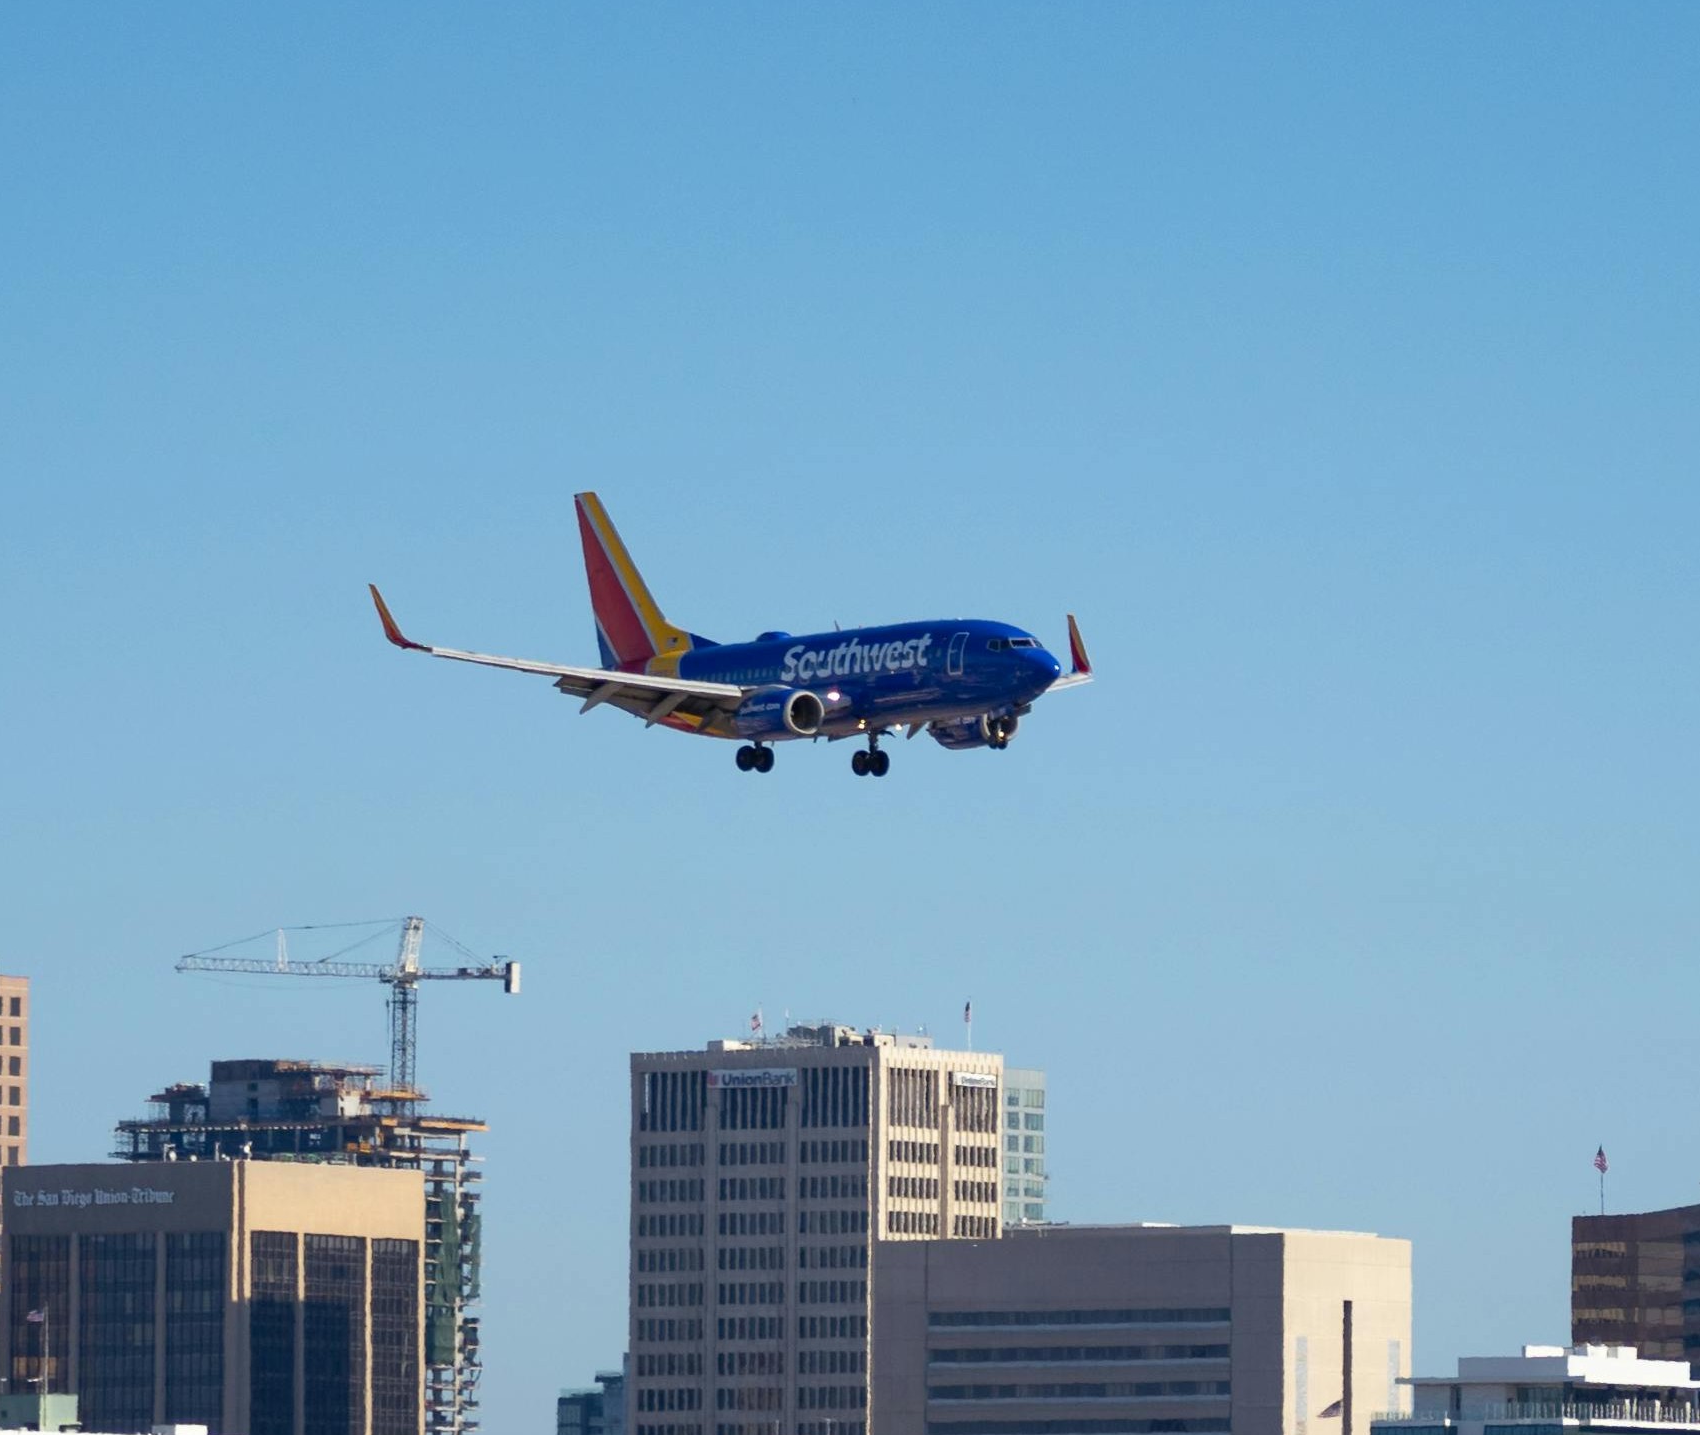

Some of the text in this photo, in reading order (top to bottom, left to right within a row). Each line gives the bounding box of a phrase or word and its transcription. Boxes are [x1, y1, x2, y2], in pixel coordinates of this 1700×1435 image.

[781, 633, 933, 682] Southwest
[722, 1072, 795, 1086] UnionBank
[13, 1187, 175, 1208] The San Diego Union-Tribune
